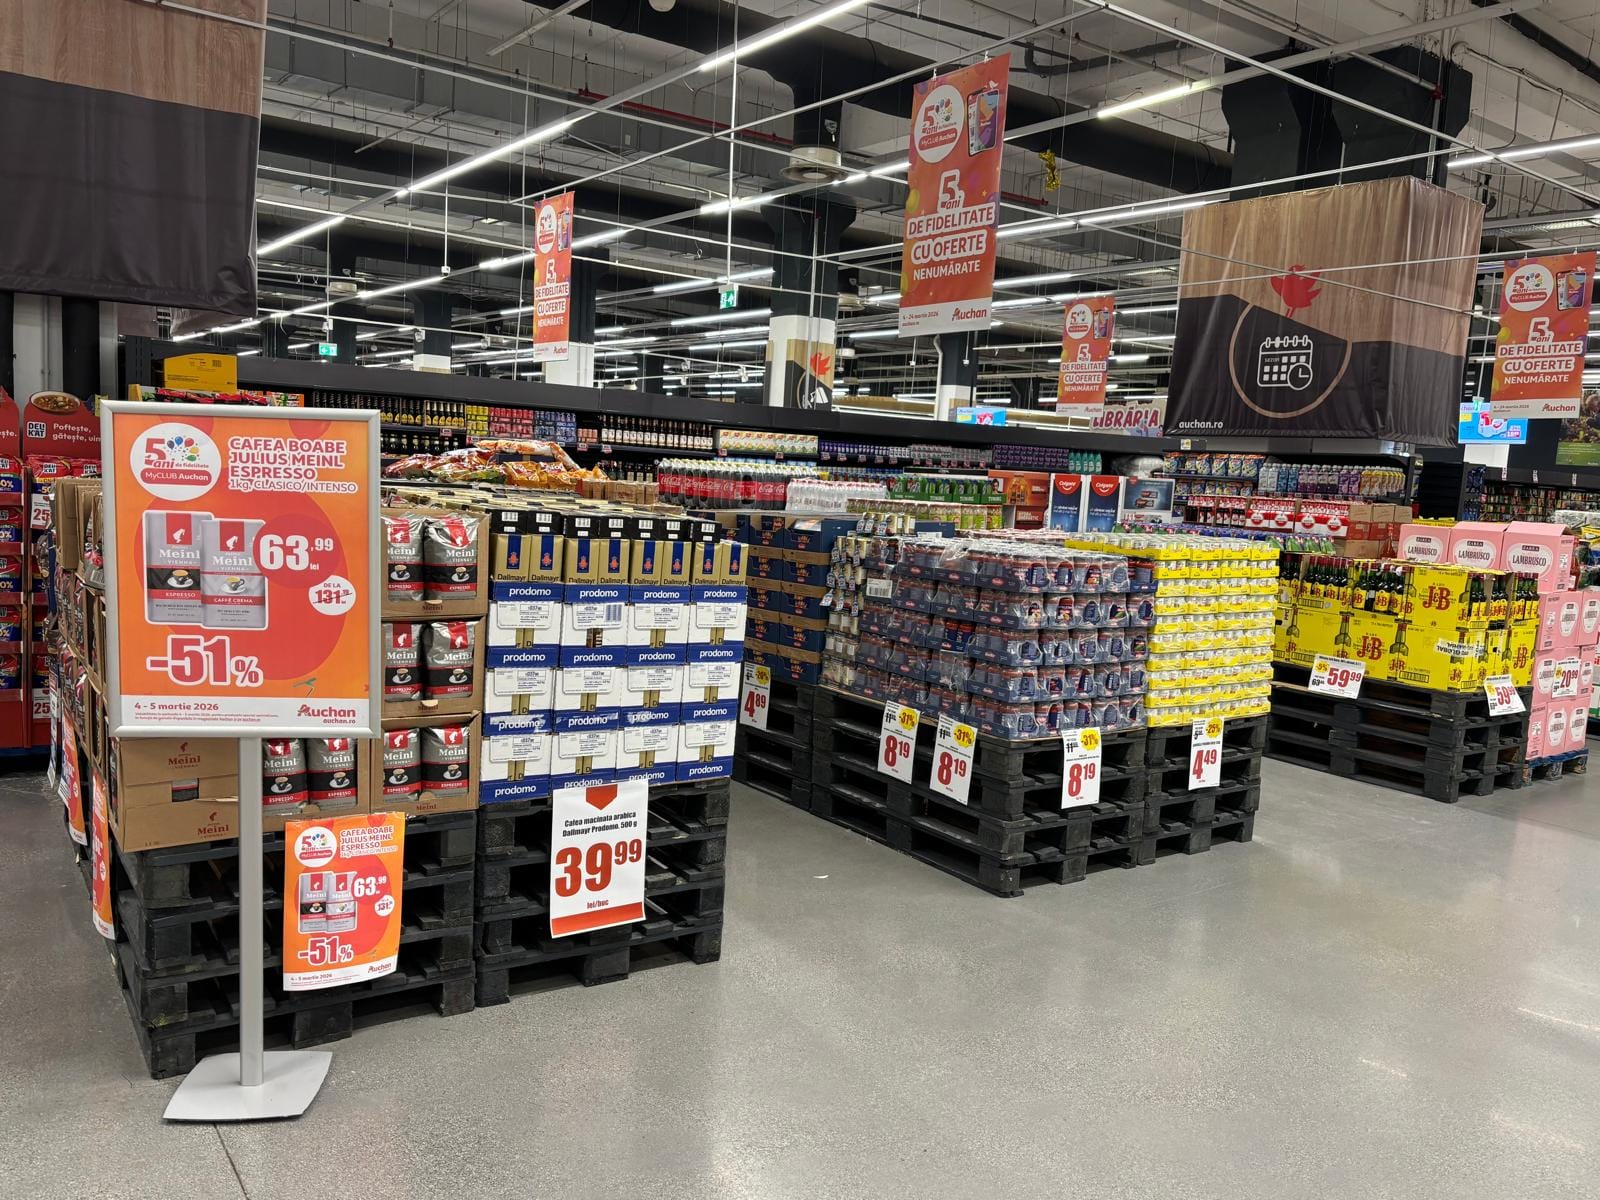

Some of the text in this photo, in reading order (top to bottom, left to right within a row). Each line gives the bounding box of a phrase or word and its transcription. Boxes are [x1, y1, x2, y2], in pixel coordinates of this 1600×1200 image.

[943, 175, 956, 201] 5
[945, 196, 961, 209] ani
[909, 206, 994, 236] DE FIDELITATE
[913, 233, 985, 261] CU OFERTE
[913, 260, 981, 281] NENUMĂRATE
[535, 284, 569, 298] DE FIDELITATE
[538, 300, 565, 314] CU OFERTE
[952, 307, 987, 322] Auchan
[1533, 320, 1546, 336] 5
[1536, 334, 1550, 342] ani
[1500, 343, 1581, 356] DE FIDELITATE
[1070, 362, 1106, 371] FIDELITATE
[1504, 359, 1573, 372] CU OFERTE
[1064, 373, 1102, 383] CU OFERTE
[1504, 373, 1570, 385] NENUMĂRATE
[1542, 403, 1576, 412] Auchan
[53, 423, 92, 434] Poftește,
[1178, 419, 1224, 429] auchan.ro
[52, 433, 87, 443] gătește,
[145, 437, 167, 465] 5
[230, 438, 345, 454] CAFEA BOABE
[153, 460, 175, 469] ani
[230, 451, 343, 468] JULIUS MEINL
[145, 472, 209, 482] MyCLUB Auchan
[230, 465, 316, 480] ESPRESSO
[254, 480, 357, 493] CLASICO/INTENSO
[160, 549, 200, 559] Meinl
[446, 549, 475, 557] Meinl
[1407, 546, 1438, 556] LAMBRUSCO
[1458, 549, 1491, 561] LAMBRUSCO
[212, 555, 253, 566] Meinl
[309, 562, 320, 570] lei
[1512, 554, 1547, 567] LAMBRUSCO
[509, 587, 552, 597] prodomo
[580, 588, 618, 599] prodomo
[643, 590, 680, 600] prodomo
[703, 589, 737, 599] prodomo
[1422, 585, 1451, 611] J&B
[1357, 635, 1382, 660] J&B
[387, 651, 417, 660] Meinl
[503, 652, 545, 663] prodomo
[573, 653, 613, 664] prodomo
[638, 652, 675, 662] prodomo
[699, 649, 733, 659] prodomo
[147, 635, 263, 687] -51%
[134, 702, 141, 710] 4
[150, 702, 156, 710] 5
[158, 702, 191, 711] martie
[193, 702, 219, 711] 2026
[297, 703, 357, 719] Auchan
[632, 710, 669, 722] prodomo
[693, 707, 728, 718] prodomo
[323, 717, 357, 725] auchan.ro
[499, 718, 540, 731] prodomo
[568, 715, 608, 728] prodomo
[899, 711, 915, 727] -31%
[954, 729, 972, 744] -31%
[1081, 733, 1099, 746] -31%
[384, 751, 413, 761] Meinl
[439, 747, 468, 757] Meinl
[168, 755, 201, 766] Meinl
[264, 757, 297, 769] Meinl
[322, 753, 355, 764] Meinl
[688, 765, 723, 776] prodomo
[495, 784, 541, 798] prodomo
[416, 803, 437, 811] Meinl
[564, 811, 637, 828] Cafea macinata arabica
[197, 824, 229, 836] Meinl
[340, 826, 393, 838] CAFEA BOABE
[562, 827, 591, 838] Dallmayr
[620, 821, 632, 829] 500
[633, 820, 638, 828] g
[341, 834, 393, 845] JULIUS MEINL
[341, 841, 381, 852] ESPRESSO
[586, 898, 609, 909] lei/buc
[299, 937, 352, 965] -51%
[367, 962, 392, 973] Auchan
